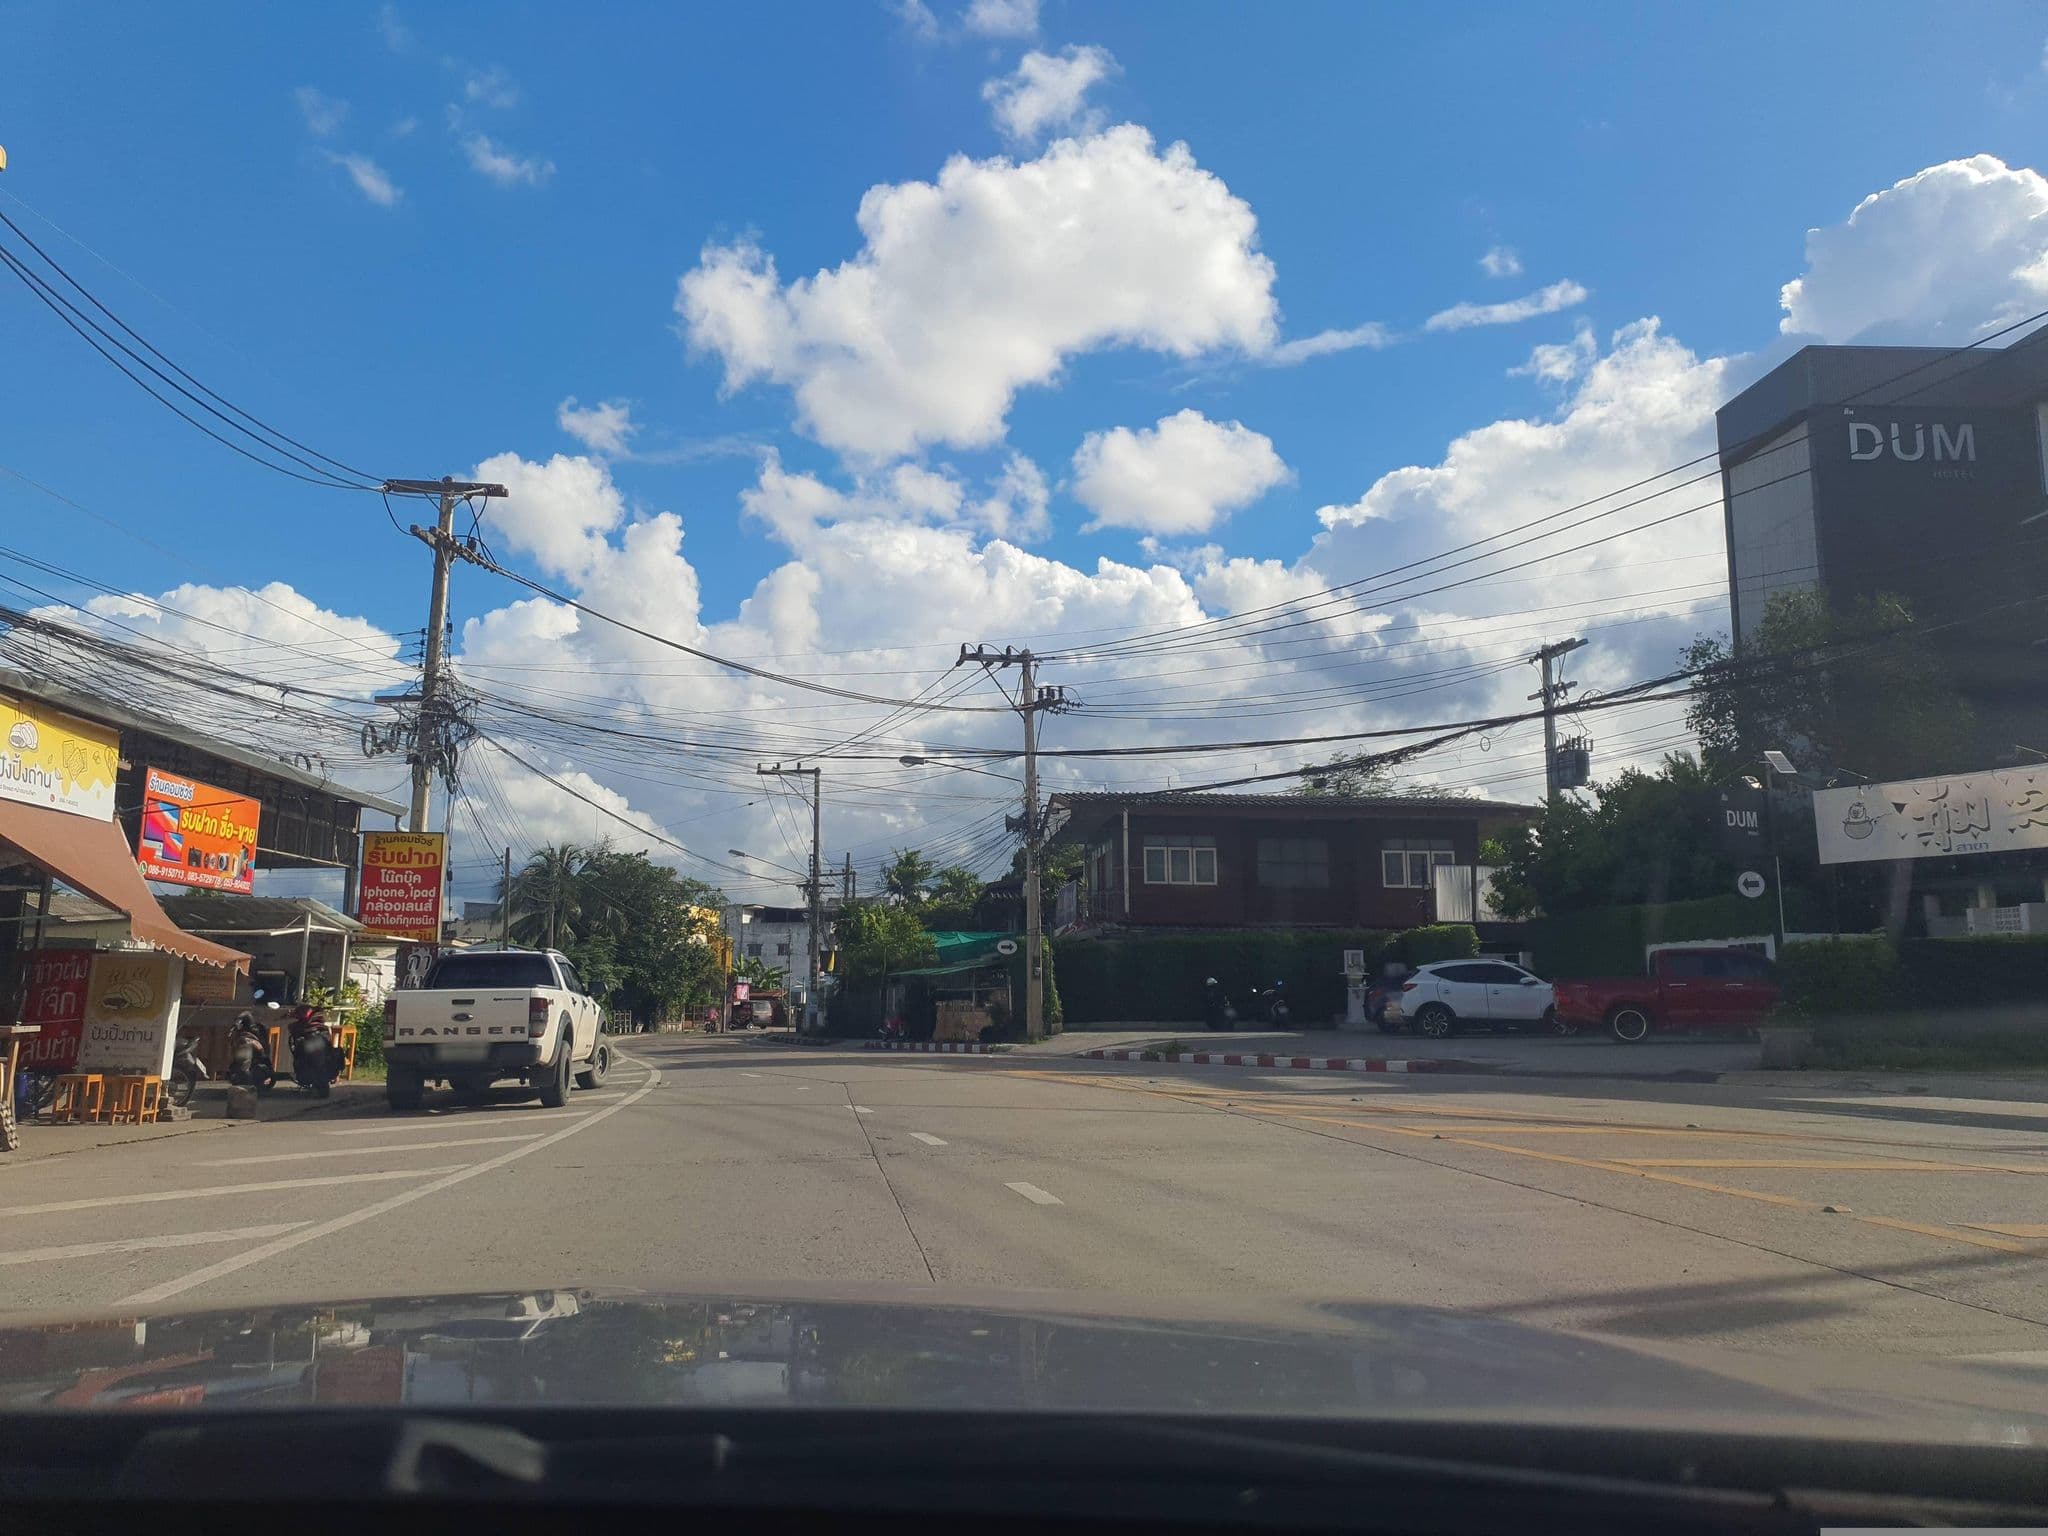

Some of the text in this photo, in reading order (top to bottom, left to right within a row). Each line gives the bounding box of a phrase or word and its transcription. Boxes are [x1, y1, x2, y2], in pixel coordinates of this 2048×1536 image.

[1848, 422, 1976, 461] DUM
[1726, 810, 1758, 828] DUM
[367, 845, 438, 865] รับฝาก
[399, 1026, 526, 1036] RANGER
